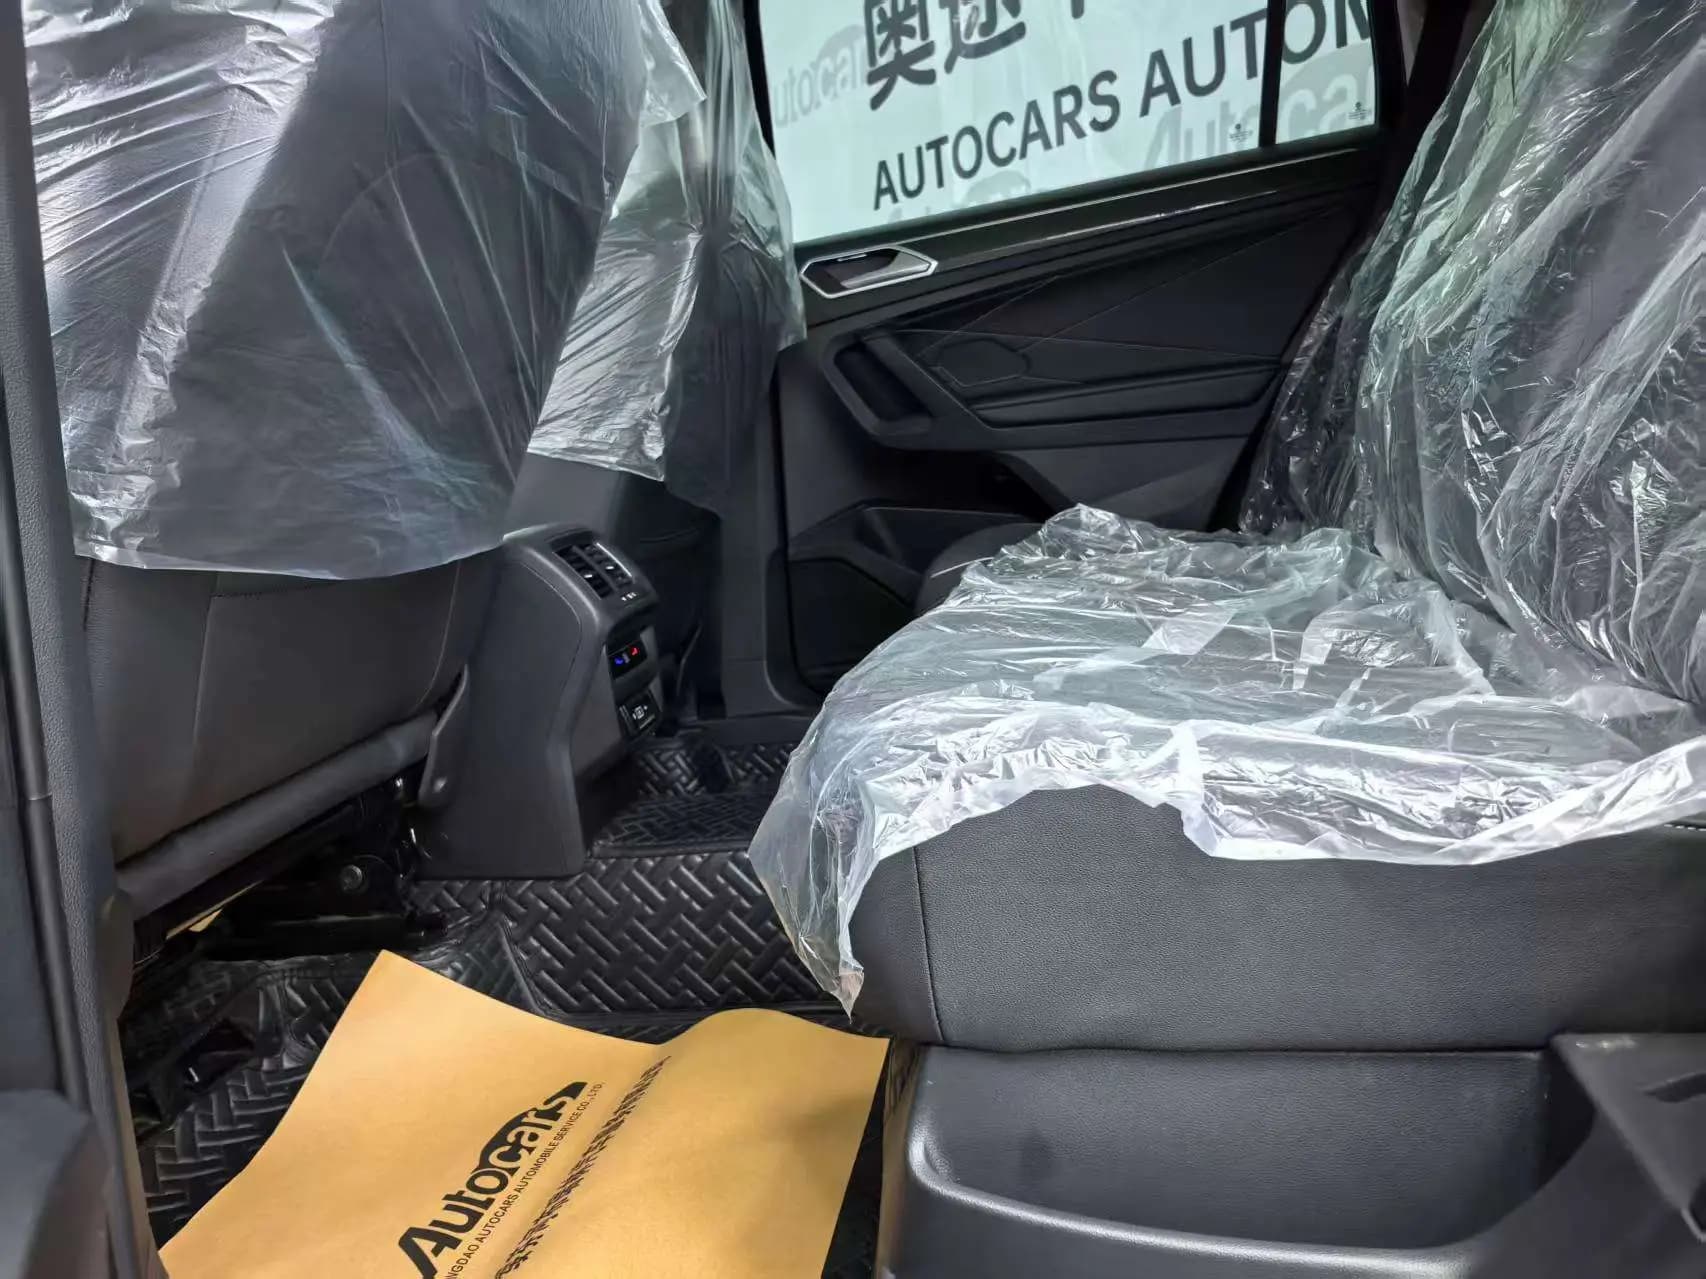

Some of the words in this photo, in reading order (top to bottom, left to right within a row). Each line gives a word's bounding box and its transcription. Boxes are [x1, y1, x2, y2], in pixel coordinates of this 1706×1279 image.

[874, 70, 1120, 210] AUTOCARS
[474, 1194, 519, 1243] AUTOCARS
[514, 1141, 559, 1194] AUTOMOBILE
[553, 1111, 582, 1141] SERVICE
